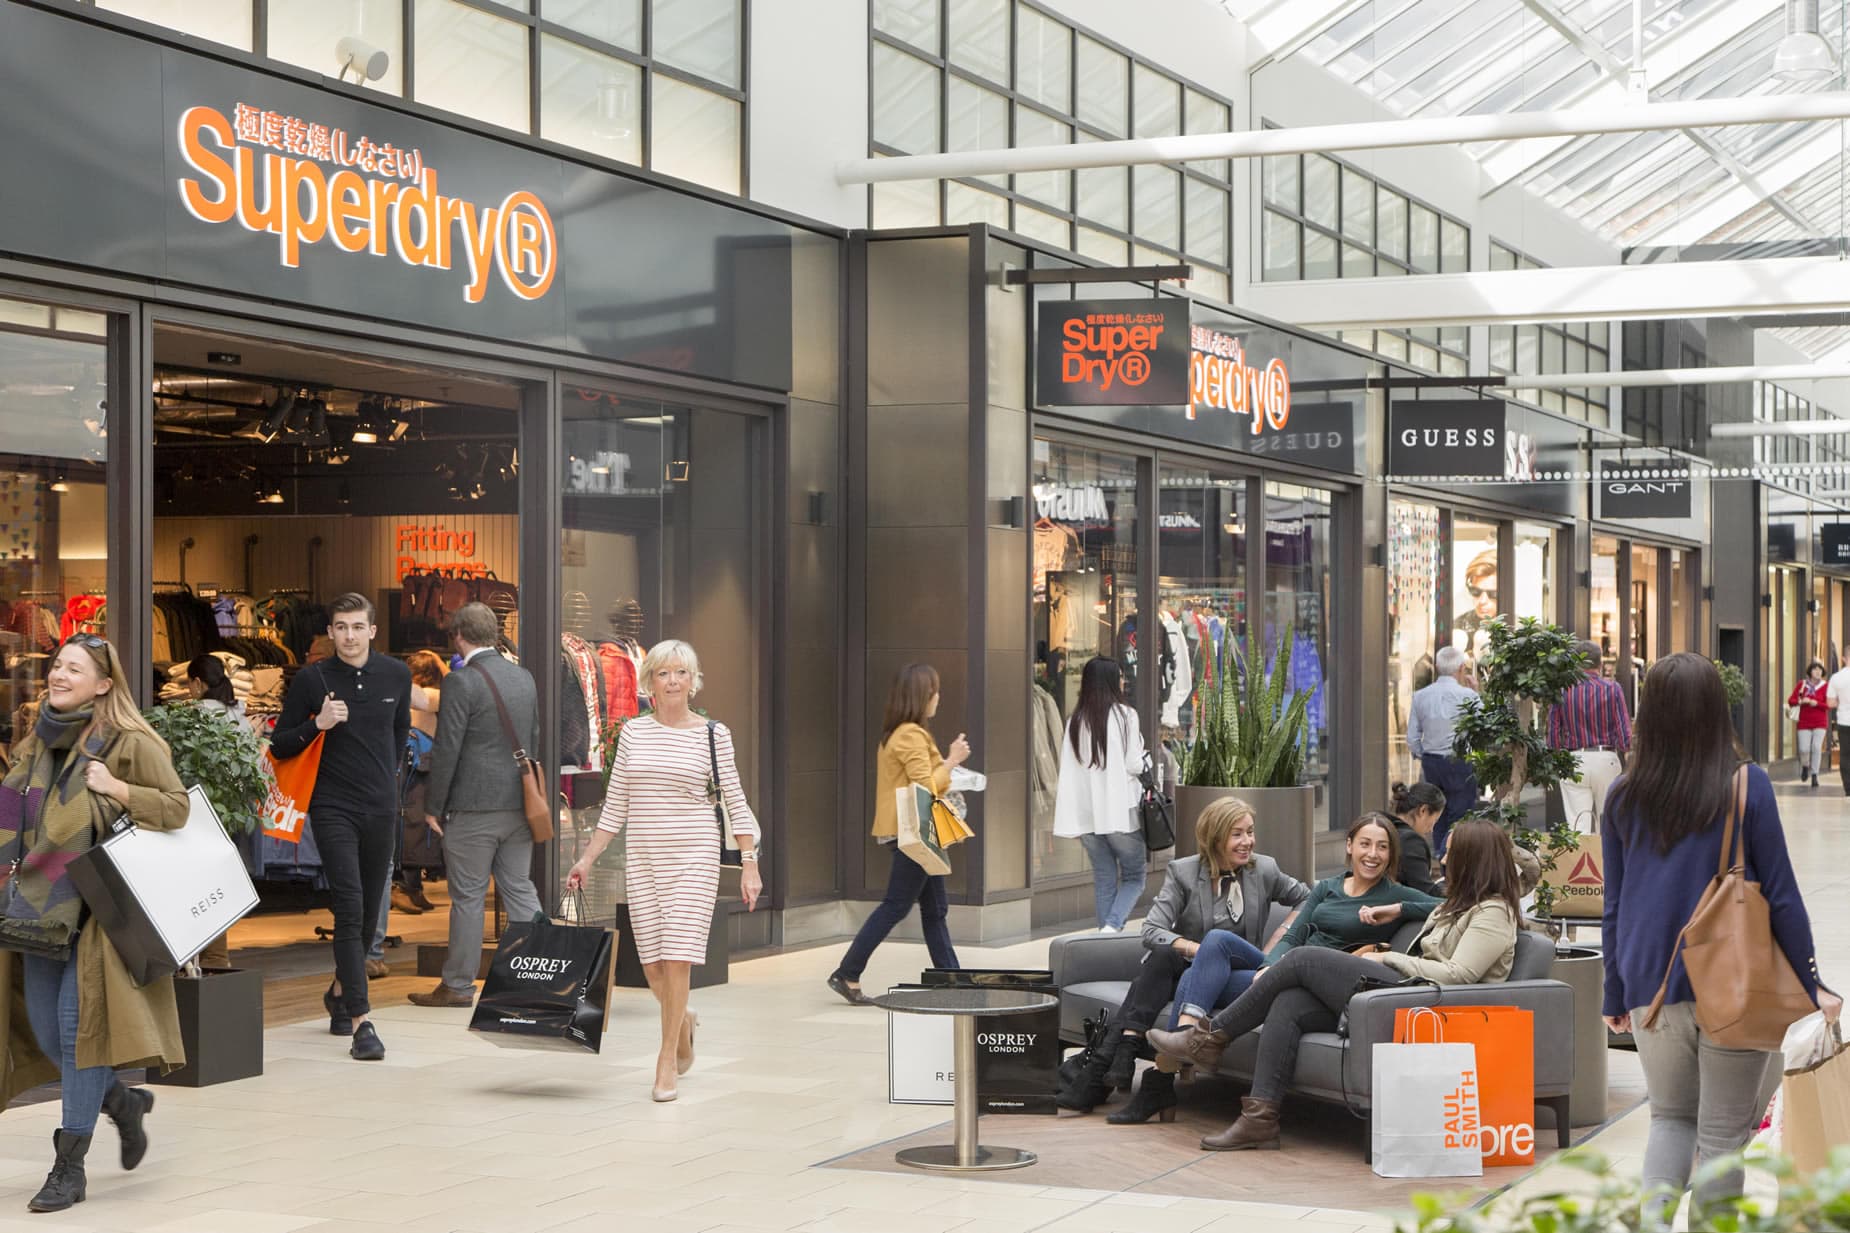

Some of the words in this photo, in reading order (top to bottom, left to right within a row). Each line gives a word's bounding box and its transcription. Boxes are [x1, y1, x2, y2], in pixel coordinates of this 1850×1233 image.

[1062, 318, 1164, 360] Super
[1401, 428, 1496, 447] GUESS
[1608, 482, 1684, 494] GANT
[396, 523, 476, 558] Fitting
[1562, 884, 1604, 896] Reebo
[191, 888, 224, 918] REISS
[510, 956, 572, 974] OSPREY
[516, 971, 555, 981] LONDON
[977, 1033, 1038, 1046] OSPREY
[1443, 1087, 1460, 1149] PAUL
[1461, 1071, 1478, 1148] SMITH
